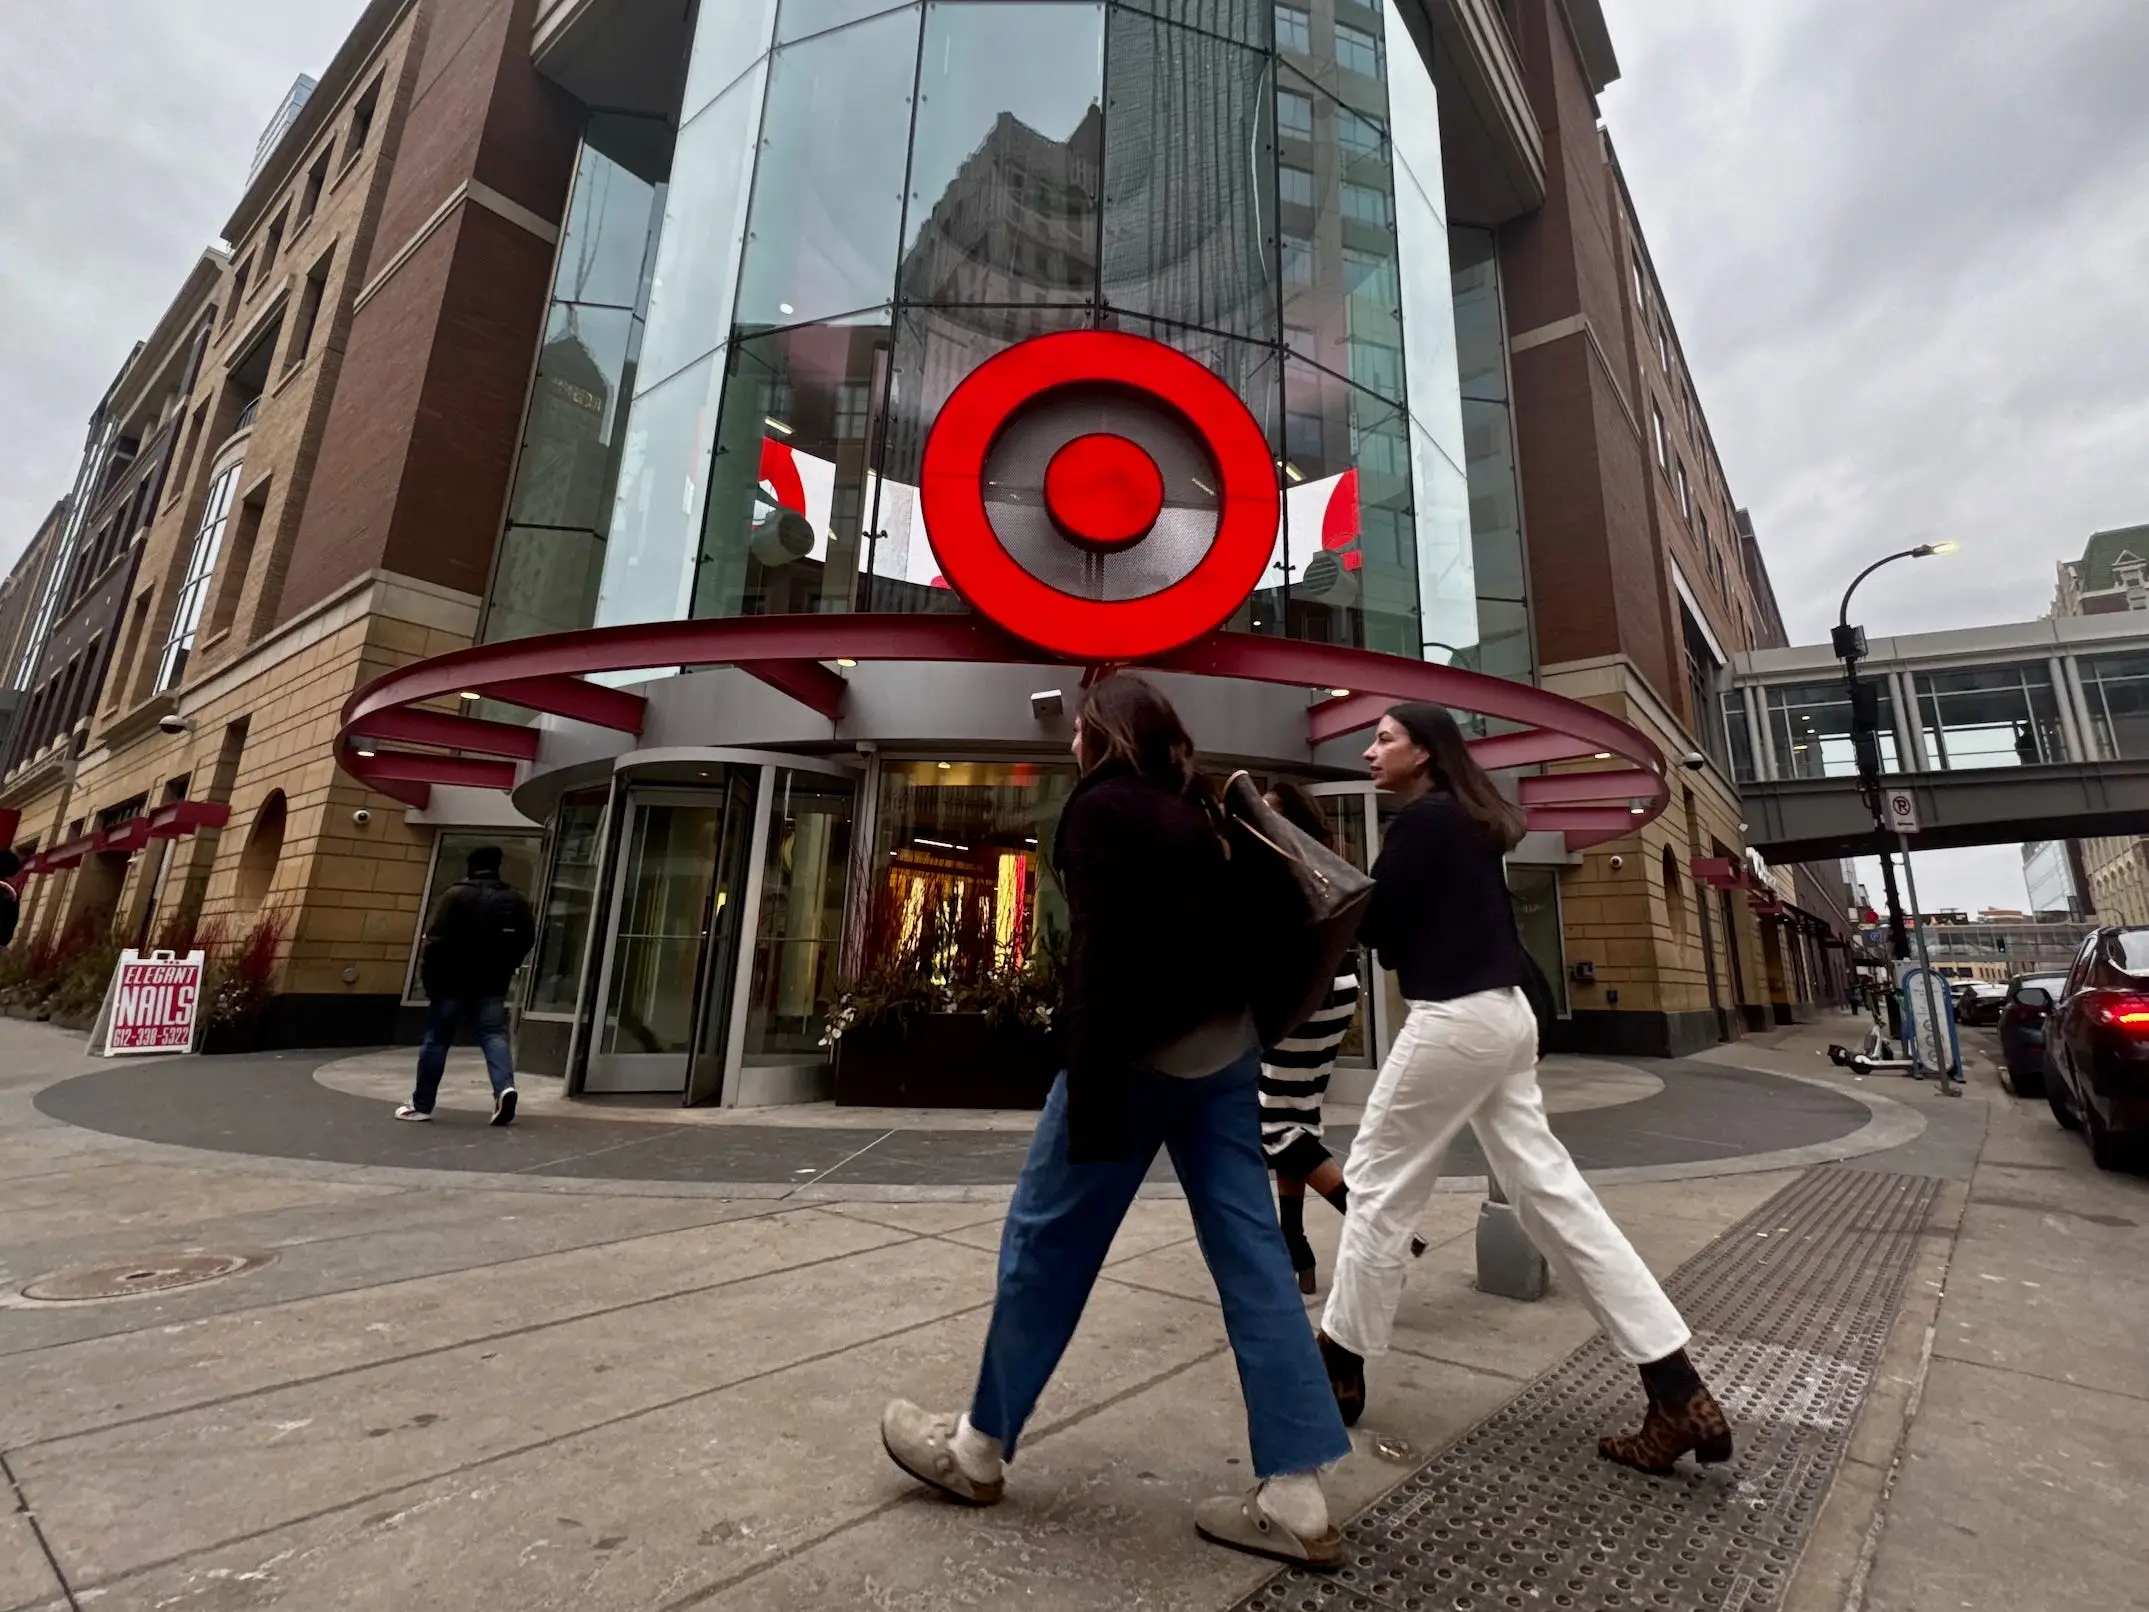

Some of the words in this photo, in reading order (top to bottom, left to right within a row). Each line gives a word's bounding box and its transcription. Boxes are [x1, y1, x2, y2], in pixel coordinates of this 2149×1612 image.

[124, 966, 195, 984] ELEGANT
[117, 985, 195, 1026] NAILS
[113, 1028, 188, 1046] 612-338-5322
